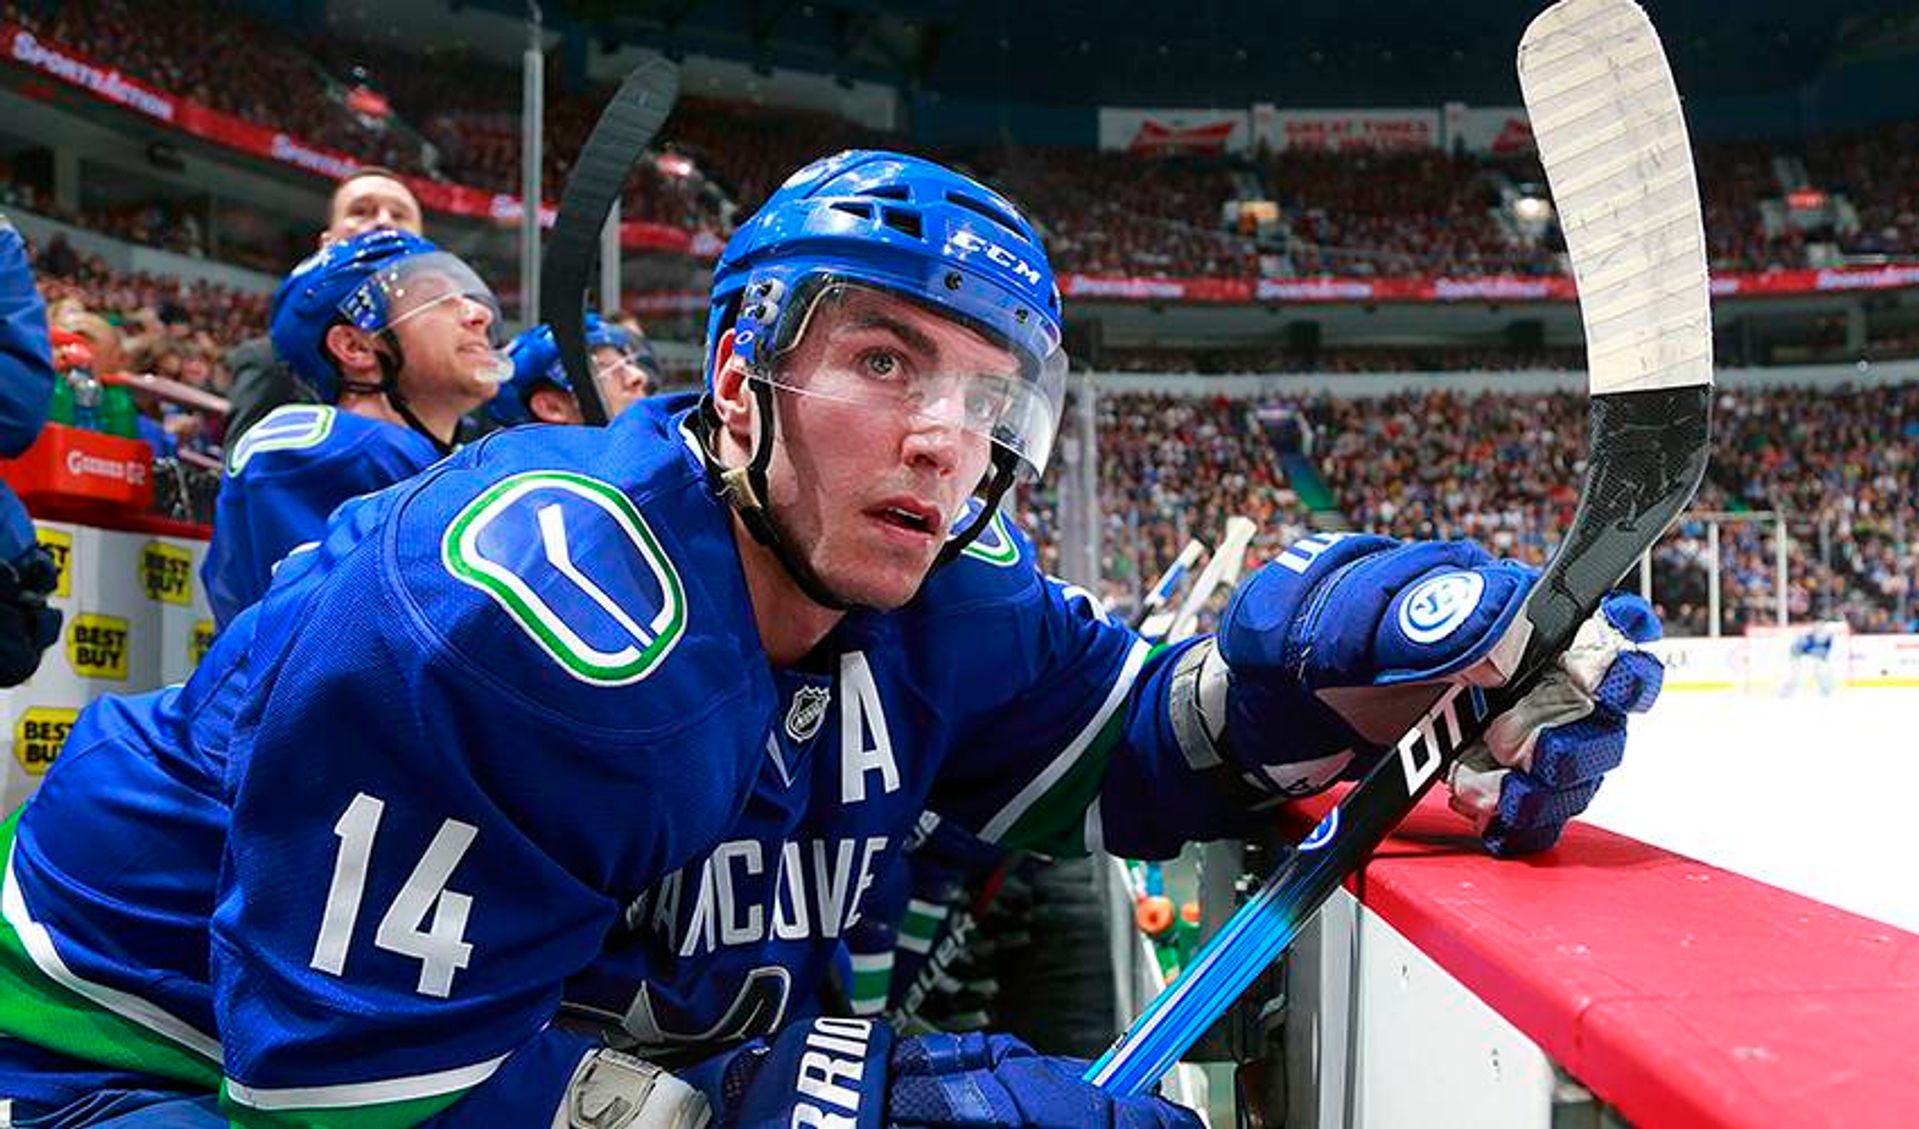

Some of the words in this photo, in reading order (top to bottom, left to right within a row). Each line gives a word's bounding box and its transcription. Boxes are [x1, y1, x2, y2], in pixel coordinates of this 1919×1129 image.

[950, 229, 1041, 286] CCM
[75, 625, 127, 649] BEST
[76, 646, 121, 669] BUY
[840, 650, 900, 804] A
[26, 743, 63, 763] BU
[309, 791, 479, 998] 14
